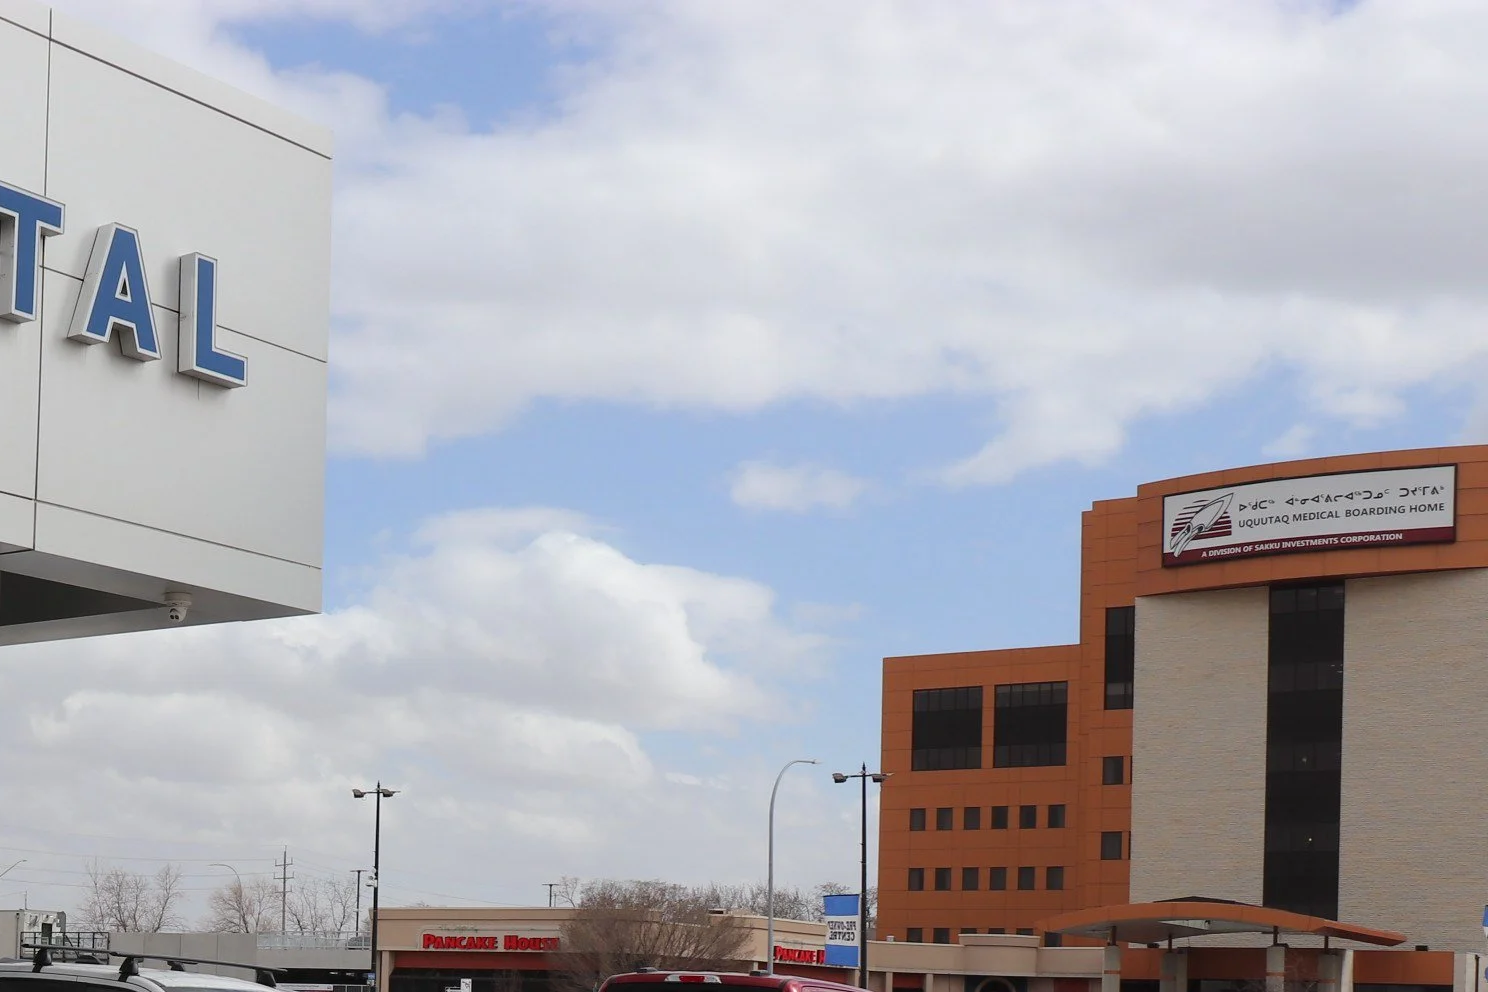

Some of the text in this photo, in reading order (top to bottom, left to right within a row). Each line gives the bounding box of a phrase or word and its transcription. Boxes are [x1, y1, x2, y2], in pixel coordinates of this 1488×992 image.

[1238, 502, 1445, 529] UQUUTAQ MEDICAL BOARDING HOME
[1208, 546, 1241, 557] DIVISION
[1242, 544, 1253, 552] OF
[1254, 541, 1281, 551] SAKKU
[1281, 537, 1339, 549] INVESTMENTS
[1340, 533, 1403, 544] CORPORATION
[422, 934, 499, 950] PANCAKE
[773, 945, 816, 963] PANCAKE
